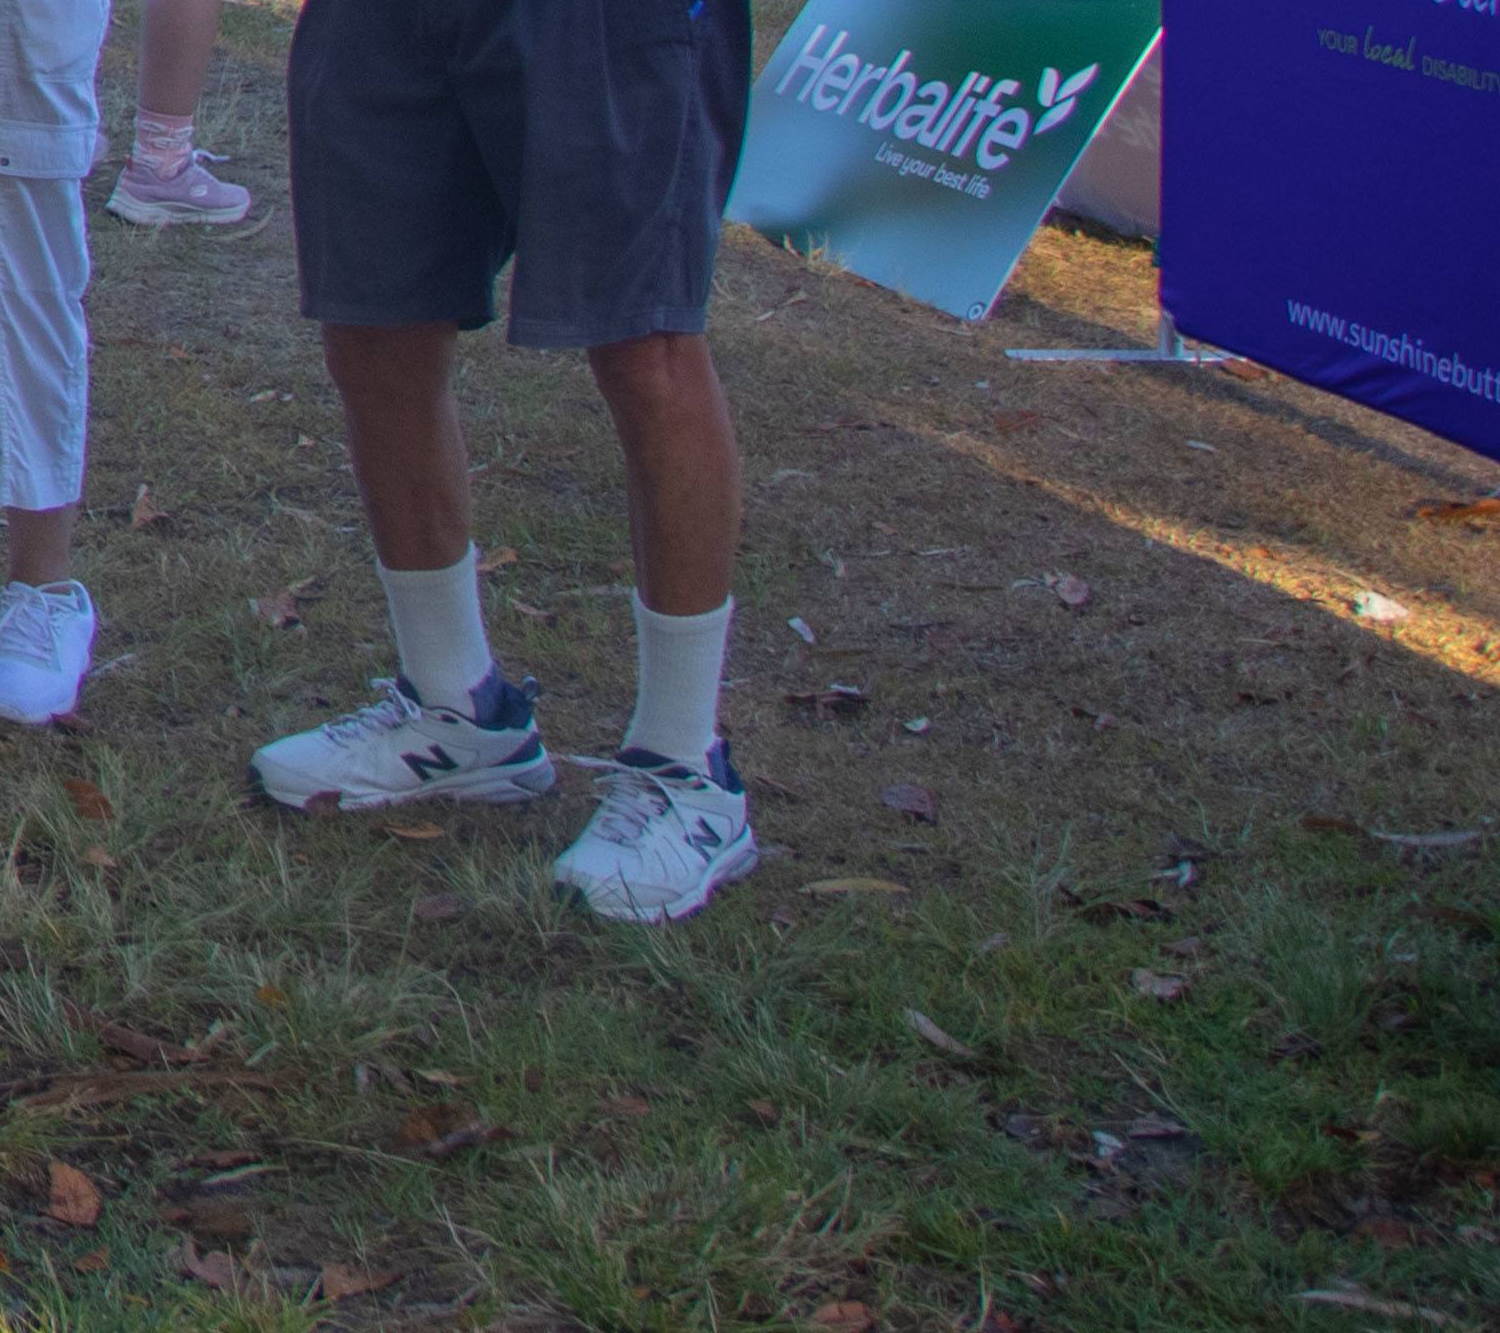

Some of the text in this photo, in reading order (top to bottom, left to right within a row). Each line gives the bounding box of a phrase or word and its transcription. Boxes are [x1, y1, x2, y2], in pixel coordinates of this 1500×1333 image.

[774, 23, 1032, 171] Herbalife
[874, 141, 992, 200] Live your best life
